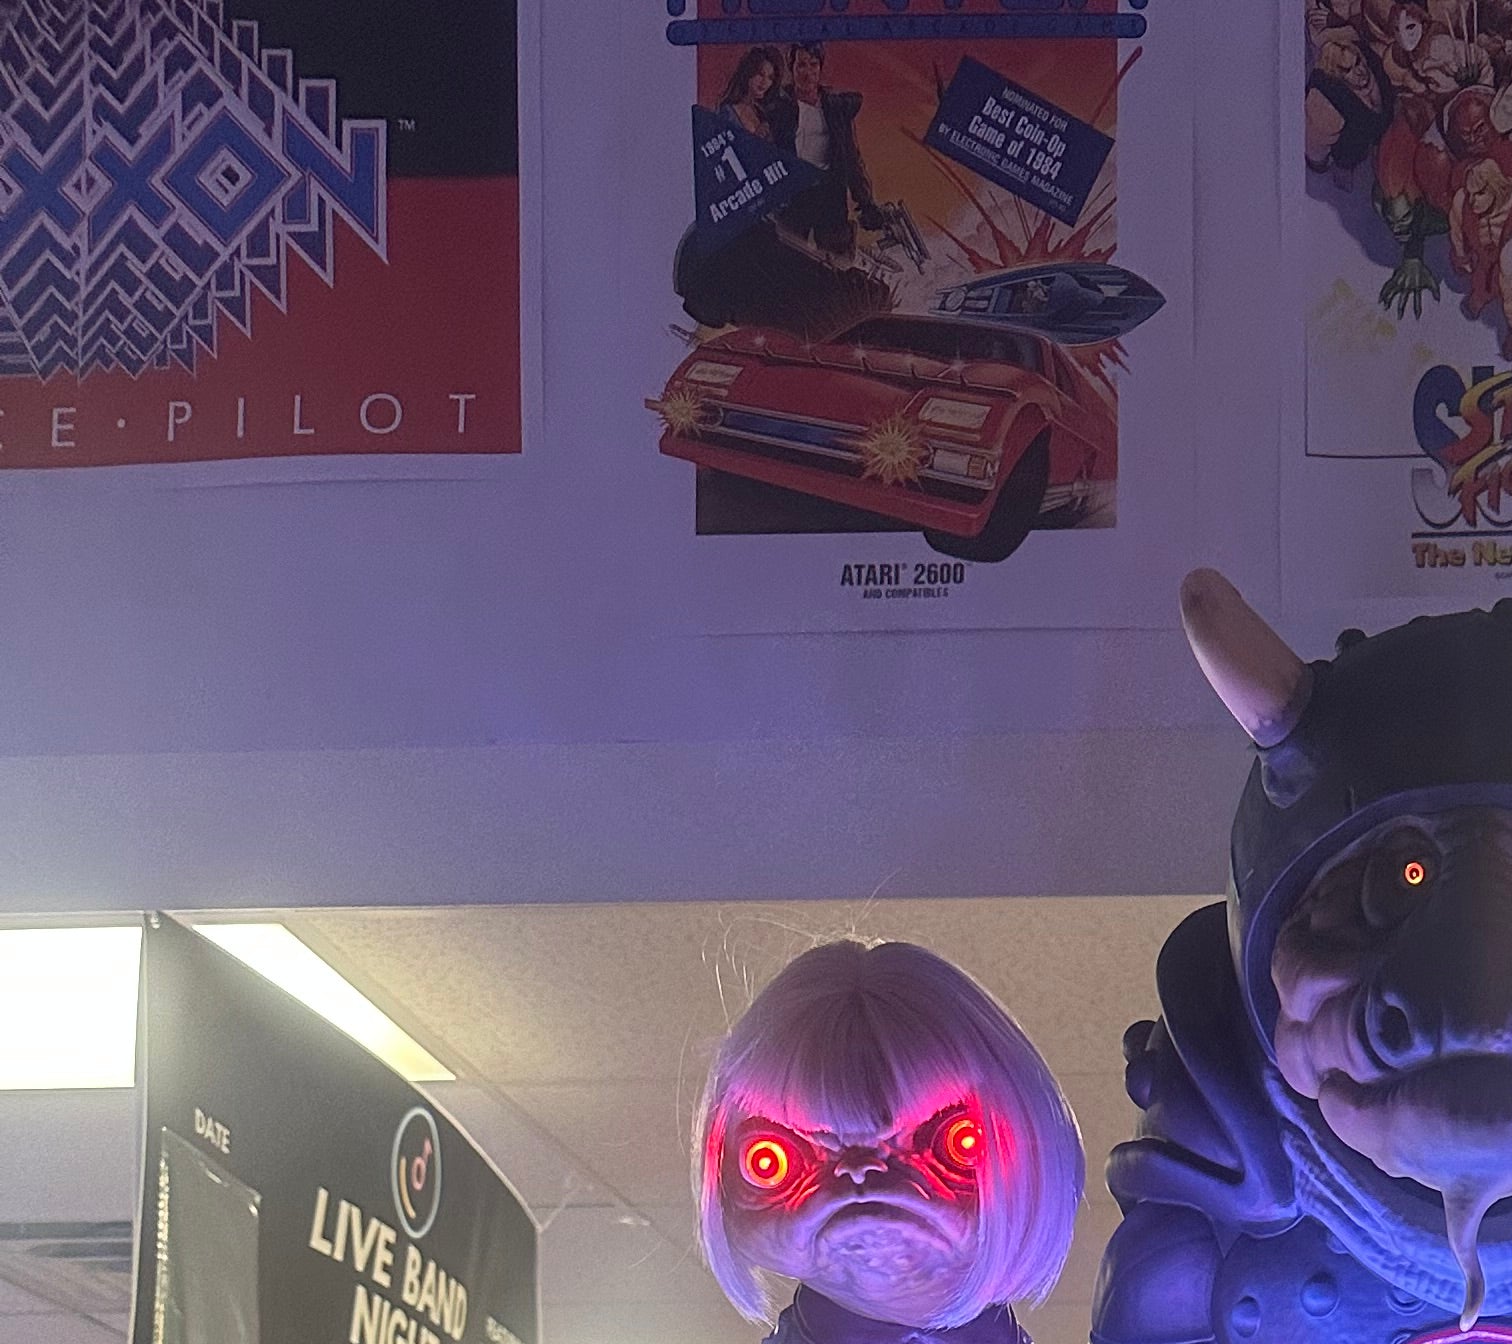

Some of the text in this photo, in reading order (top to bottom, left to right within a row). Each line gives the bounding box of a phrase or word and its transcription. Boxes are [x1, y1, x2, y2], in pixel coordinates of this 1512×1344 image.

[968, 116, 1062, 180] Game of 1984
[982, 96, 1066, 158] Best Coin-Op
[709, 160, 789, 222] Arcade Hit
[166, 394, 476, 442] PILOT
[913, 562, 965, 585] 2600
[1411, 541, 1466, 569] The
[863, 586, 949, 599] AND COMPATIBLES
[194, 1107, 231, 1154] DATE
[309, 1186, 468, 1342] LIVE BAND
